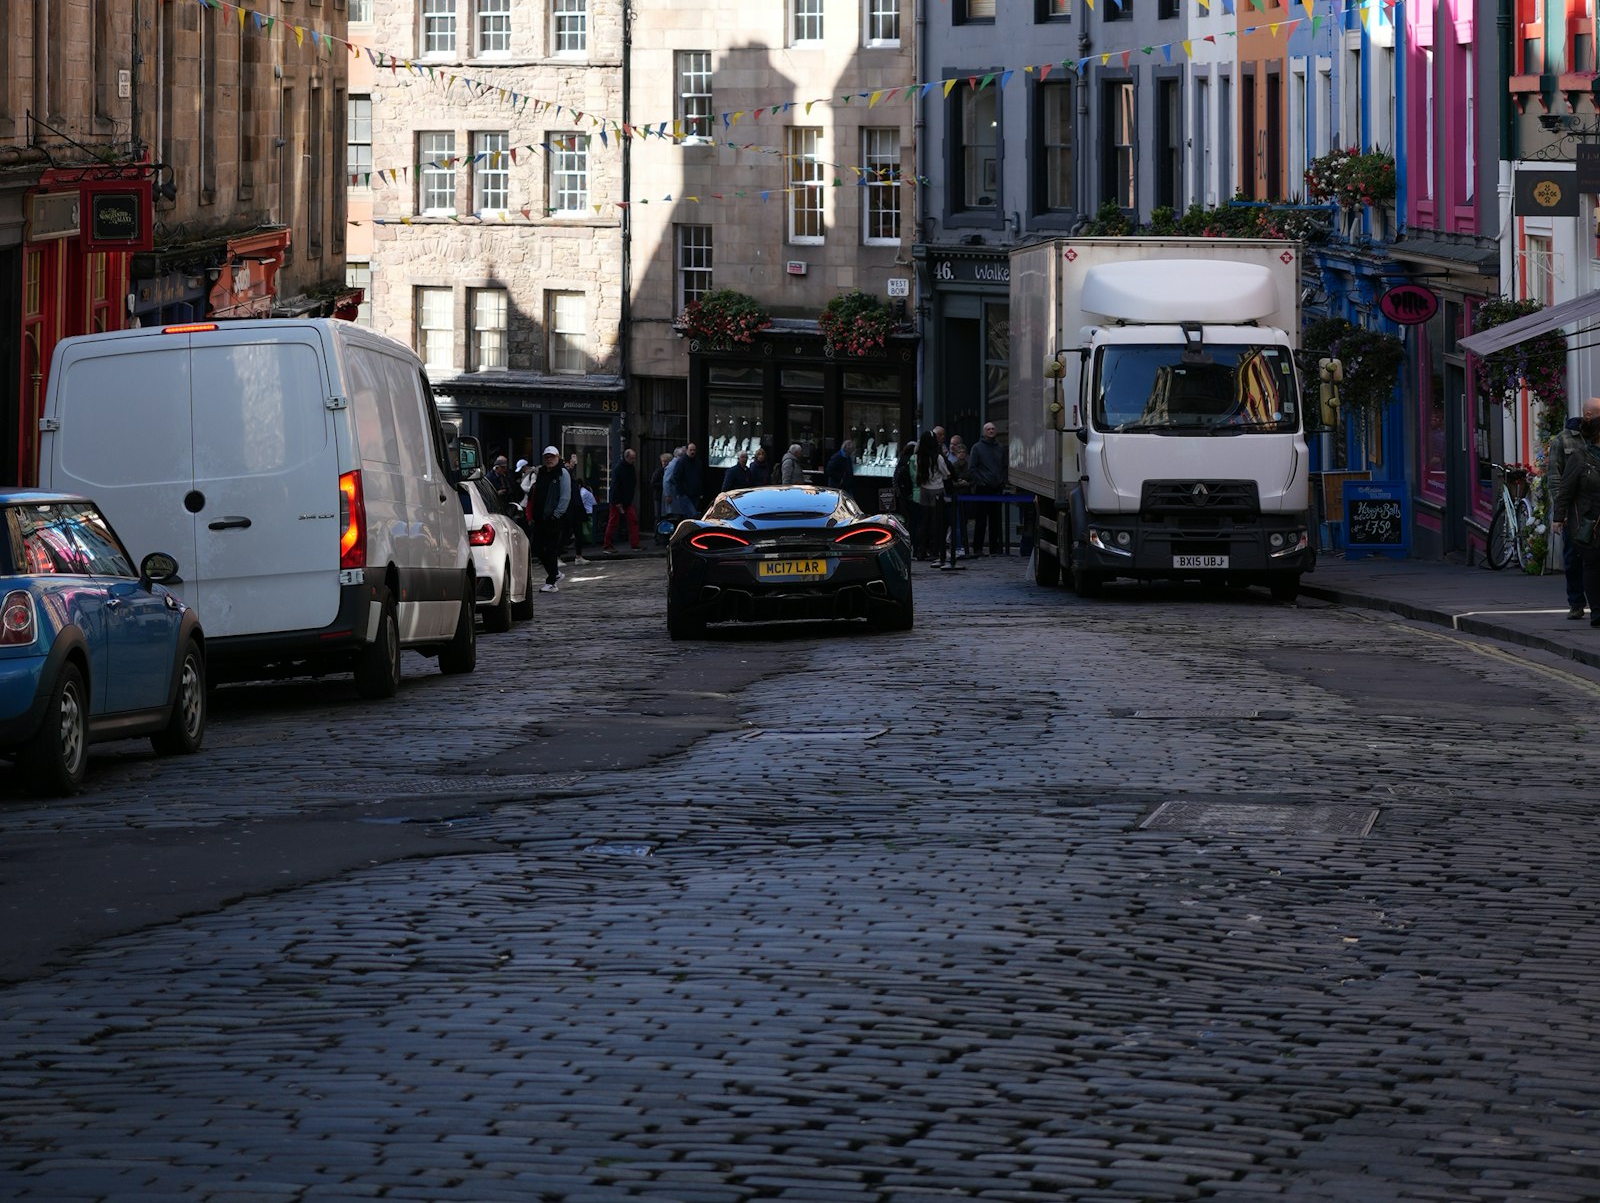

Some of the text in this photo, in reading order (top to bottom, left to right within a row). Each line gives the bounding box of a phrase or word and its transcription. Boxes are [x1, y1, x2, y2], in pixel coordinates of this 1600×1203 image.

[933, 261, 955, 280] 46.
[602, 399, 619, 412] 89
[766, 561, 819, 574] MC17 LAR
[1179, 557, 1223, 567] BX15 UBJ
